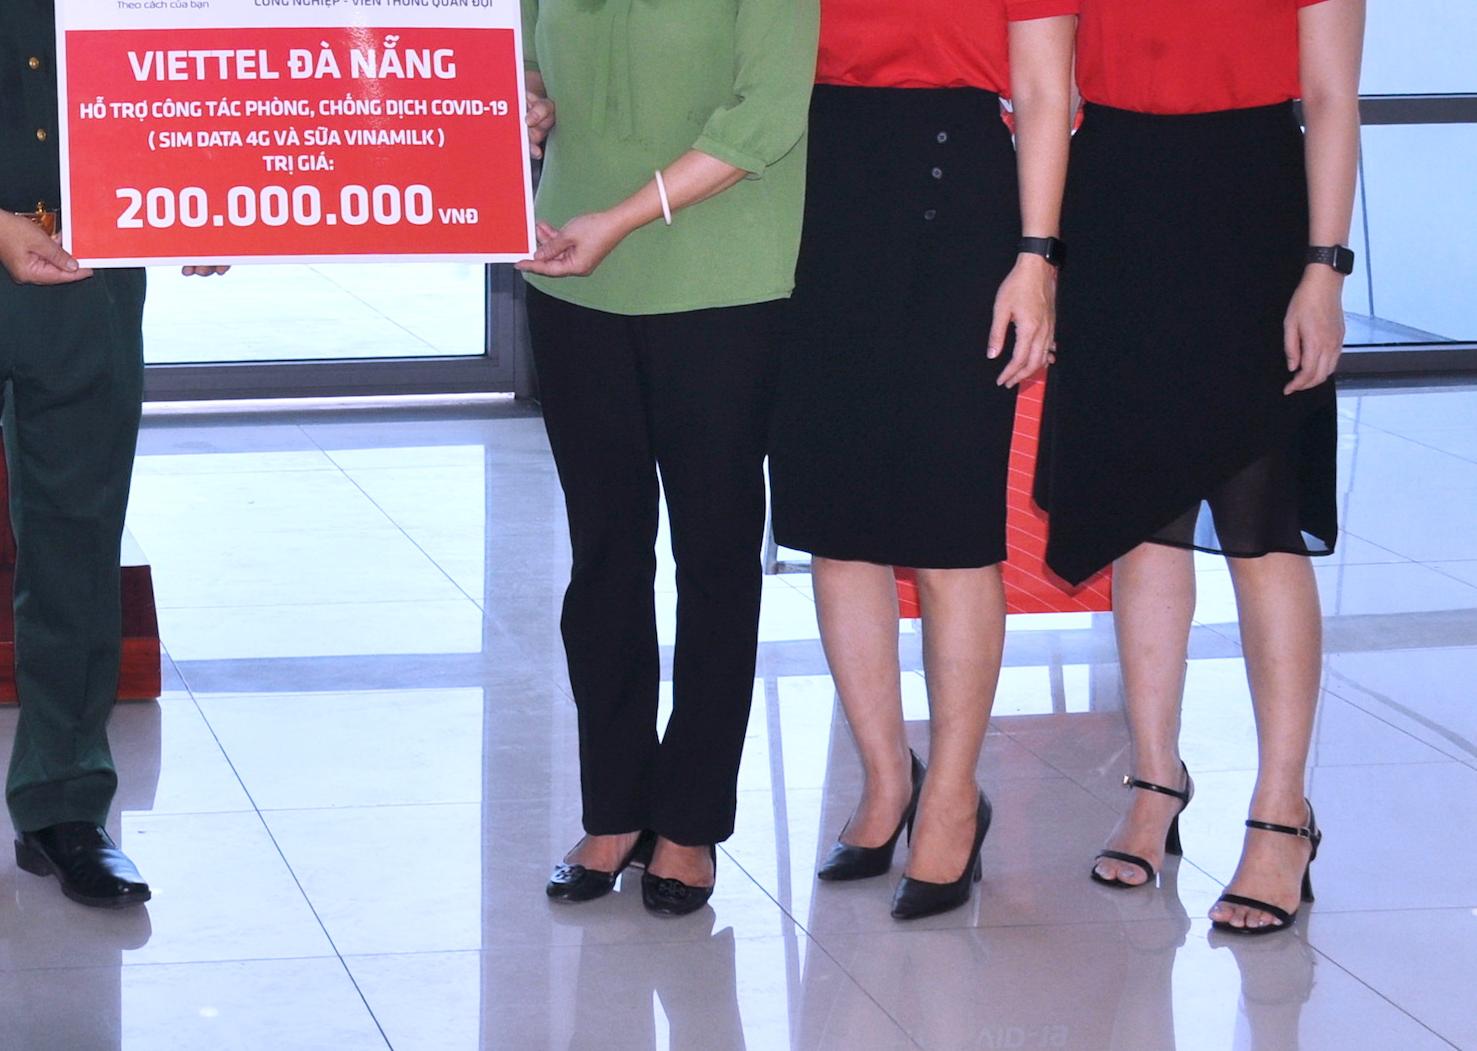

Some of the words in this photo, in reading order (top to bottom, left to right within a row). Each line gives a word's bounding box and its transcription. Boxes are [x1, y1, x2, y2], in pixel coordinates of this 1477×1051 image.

[117, 0, 142, 10] Theo
[143, 0, 168, 9] cách
[127, 49, 280, 81] VIETTEL
[287, 40, 342, 80] ĐÀ
[350, 34, 456, 80] NẴNG
[79, 96, 107, 119] HỖ
[109, 99, 148, 122] TRỢ
[151, 98, 202, 118] CÔNG
[205, 97, 242, 117] TÁC
[245, 96, 315, 118] PHÒNG,
[319, 92, 382, 116] CHỐNG
[385, 99, 428, 119] DỊCH
[431, 99, 508, 116] COVID-19
[196, 130, 243, 147] DATA
[245, 130, 271, 147] 4G
[273, 126, 301, 147] VÀ
[303, 126, 342, 146] SỮA
[262, 155, 294, 175] TRỊ
[297, 151, 334, 171] GIÁ:
[115, 184, 433, 229] 200.000.000
[438, 207, 479, 225] VNĐ
